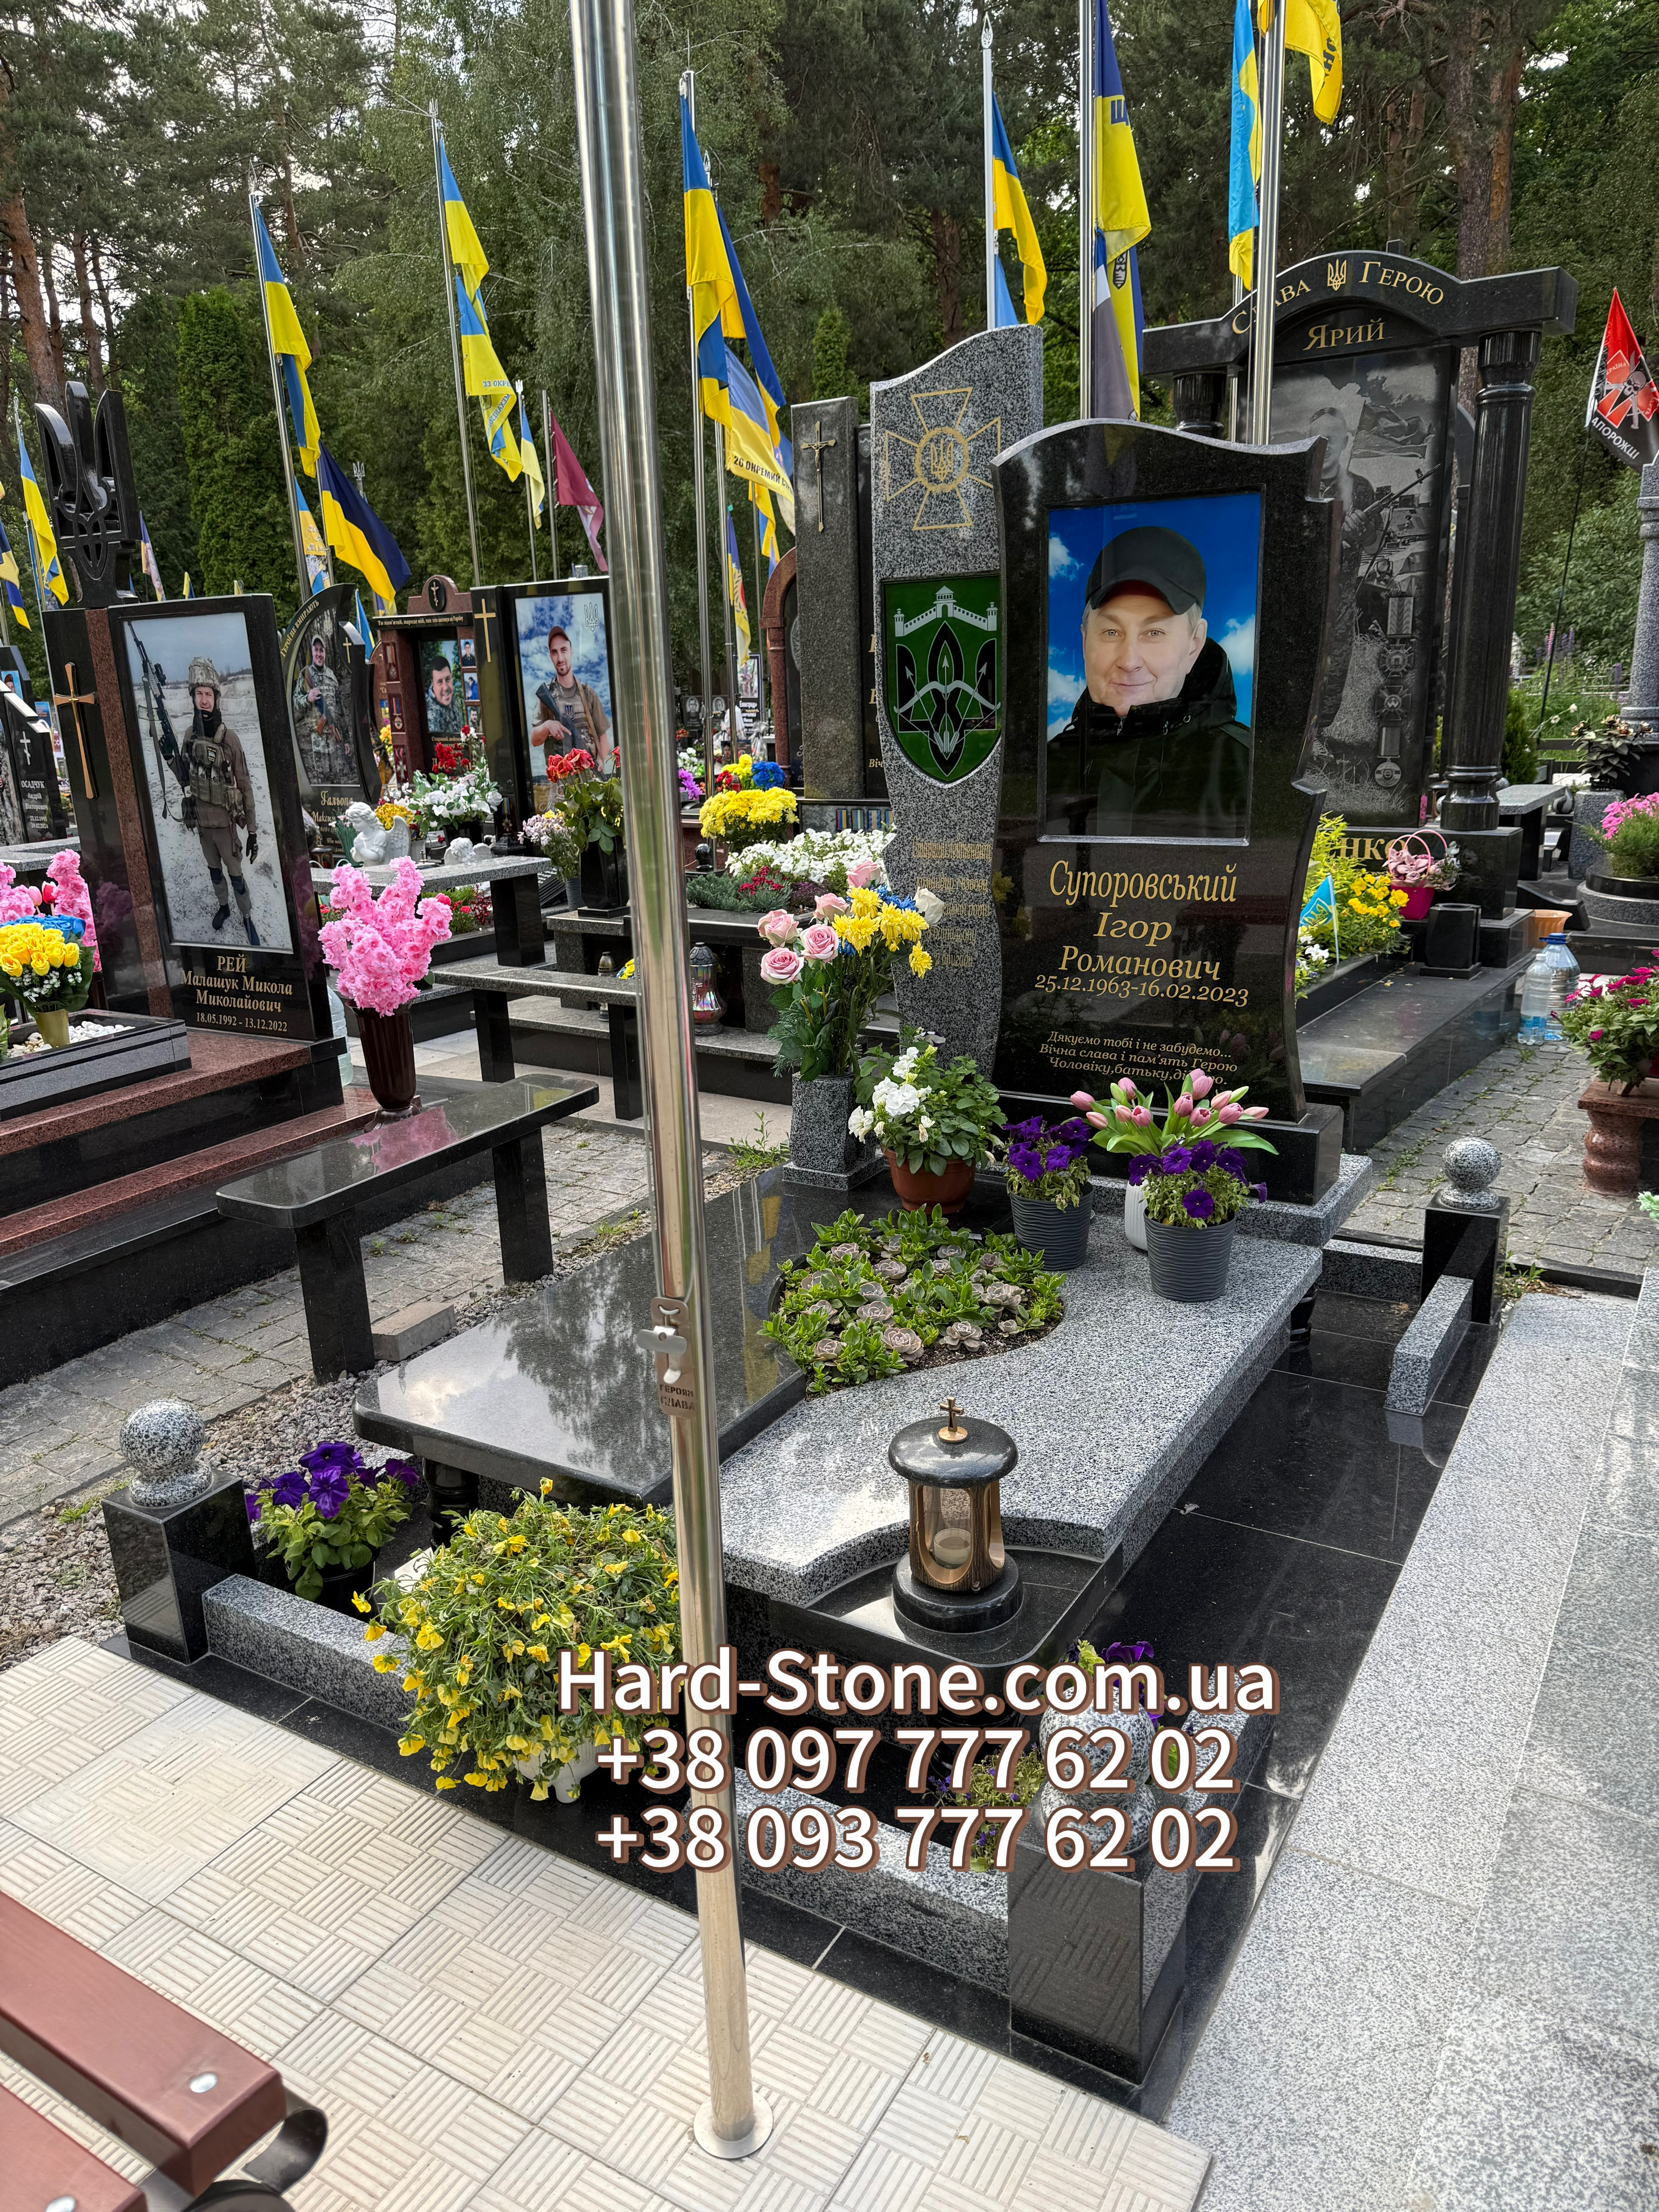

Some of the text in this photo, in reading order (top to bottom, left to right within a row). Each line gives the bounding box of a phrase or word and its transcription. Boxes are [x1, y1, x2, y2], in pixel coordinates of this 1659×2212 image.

[733, 455, 744, 468] 26
[745, 460, 780, 484] ОКРЕМИЙ
[21, 780, 45, 789] ОСАДЧУК
[1049, 860, 1237, 908] Супоровський
[1093, 912, 1172, 947] Ігор
[217, 954, 246, 973] РЕЙ
[1058, 946, 1220, 981] Романович
[181, 970, 293, 995] Малашук Микола
[1034, 974, 1249, 1007] 25.12.1963-16.02.2023
[195, 989, 282, 1013] Миколайович
[196, 1012, 237, 1027] 18.05.1992
[245, 1017, 288, 1032] 13.12.2022
[1047, 1031, 1101, 1046] Дякуємо
[1103, 1037, 1134, 1049] тобі
[1136, 1038, 1141, 1049] і
[1143, 1042, 1157, 1050] не
[1039, 1044, 1076, 1056] Вічна
[1079, 1049, 1117, 1061] слава
[1121, 1051, 1125, 1061] і
[1191, 1058, 1238, 1073] Герою
[659, 1384, 694, 1398] ГЕРОЯМ
[660, 1396, 696, 1411] СЛАВА
